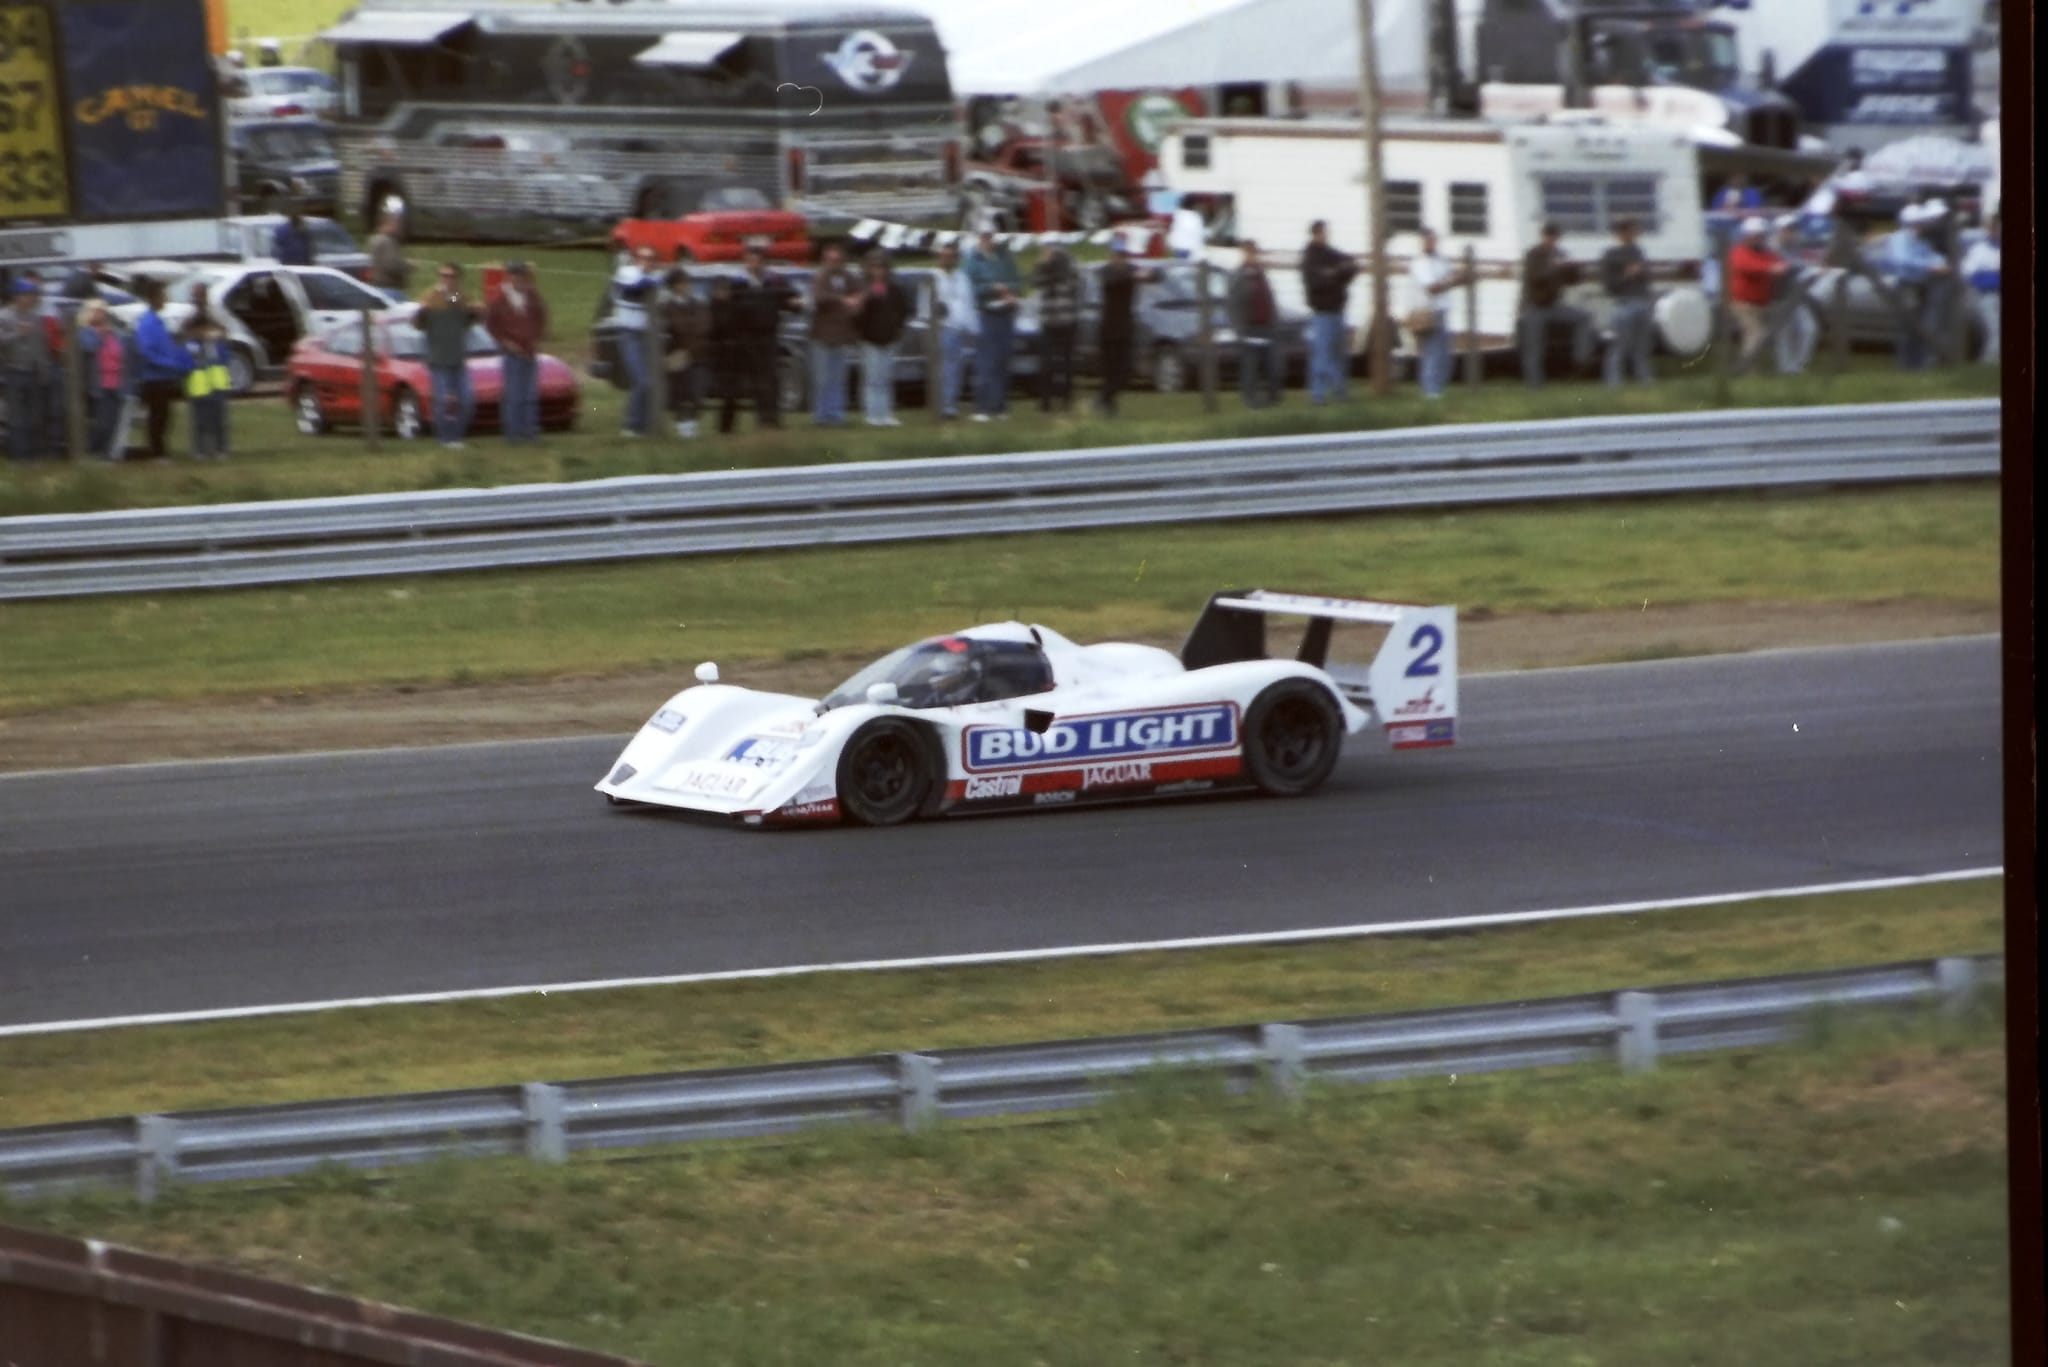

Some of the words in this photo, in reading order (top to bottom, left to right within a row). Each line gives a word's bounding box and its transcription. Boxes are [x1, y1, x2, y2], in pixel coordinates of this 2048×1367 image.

[1404, 623, 1443, 678] 2
[978, 727, 1079, 760] BUD
[1090, 713, 1222, 749] LIGHT
[964, 774, 1022, 799] Castrol
[1082, 760, 1152, 790] JAGUAR
